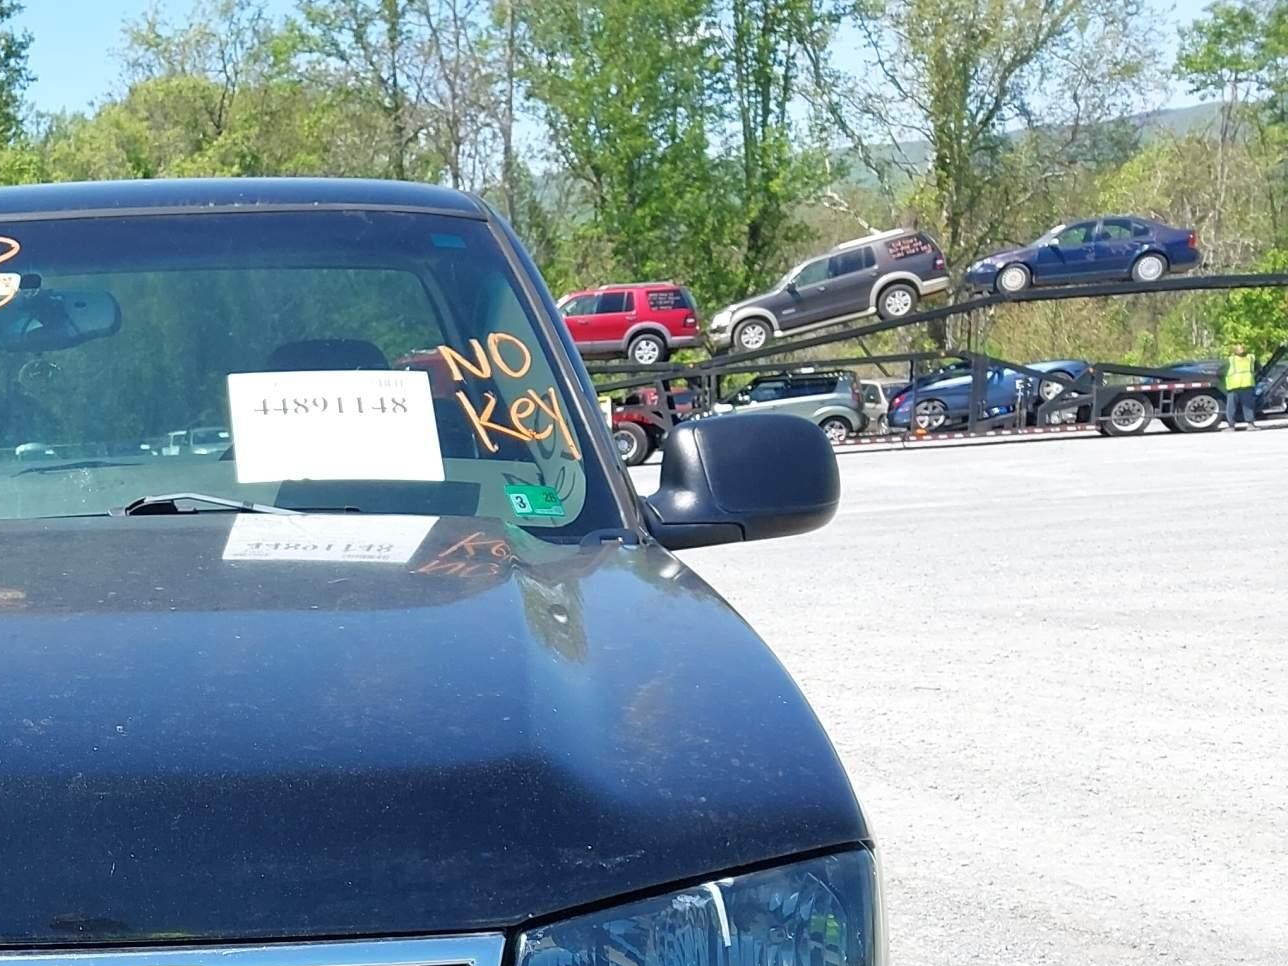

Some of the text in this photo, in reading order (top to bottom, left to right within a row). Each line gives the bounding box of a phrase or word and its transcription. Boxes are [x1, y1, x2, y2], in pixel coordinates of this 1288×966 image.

[437, 332, 532, 381] NO
[253, 396, 409, 416] 44891148
[455, 386, 583, 461] Key
[515, 495, 526, 508] 3
